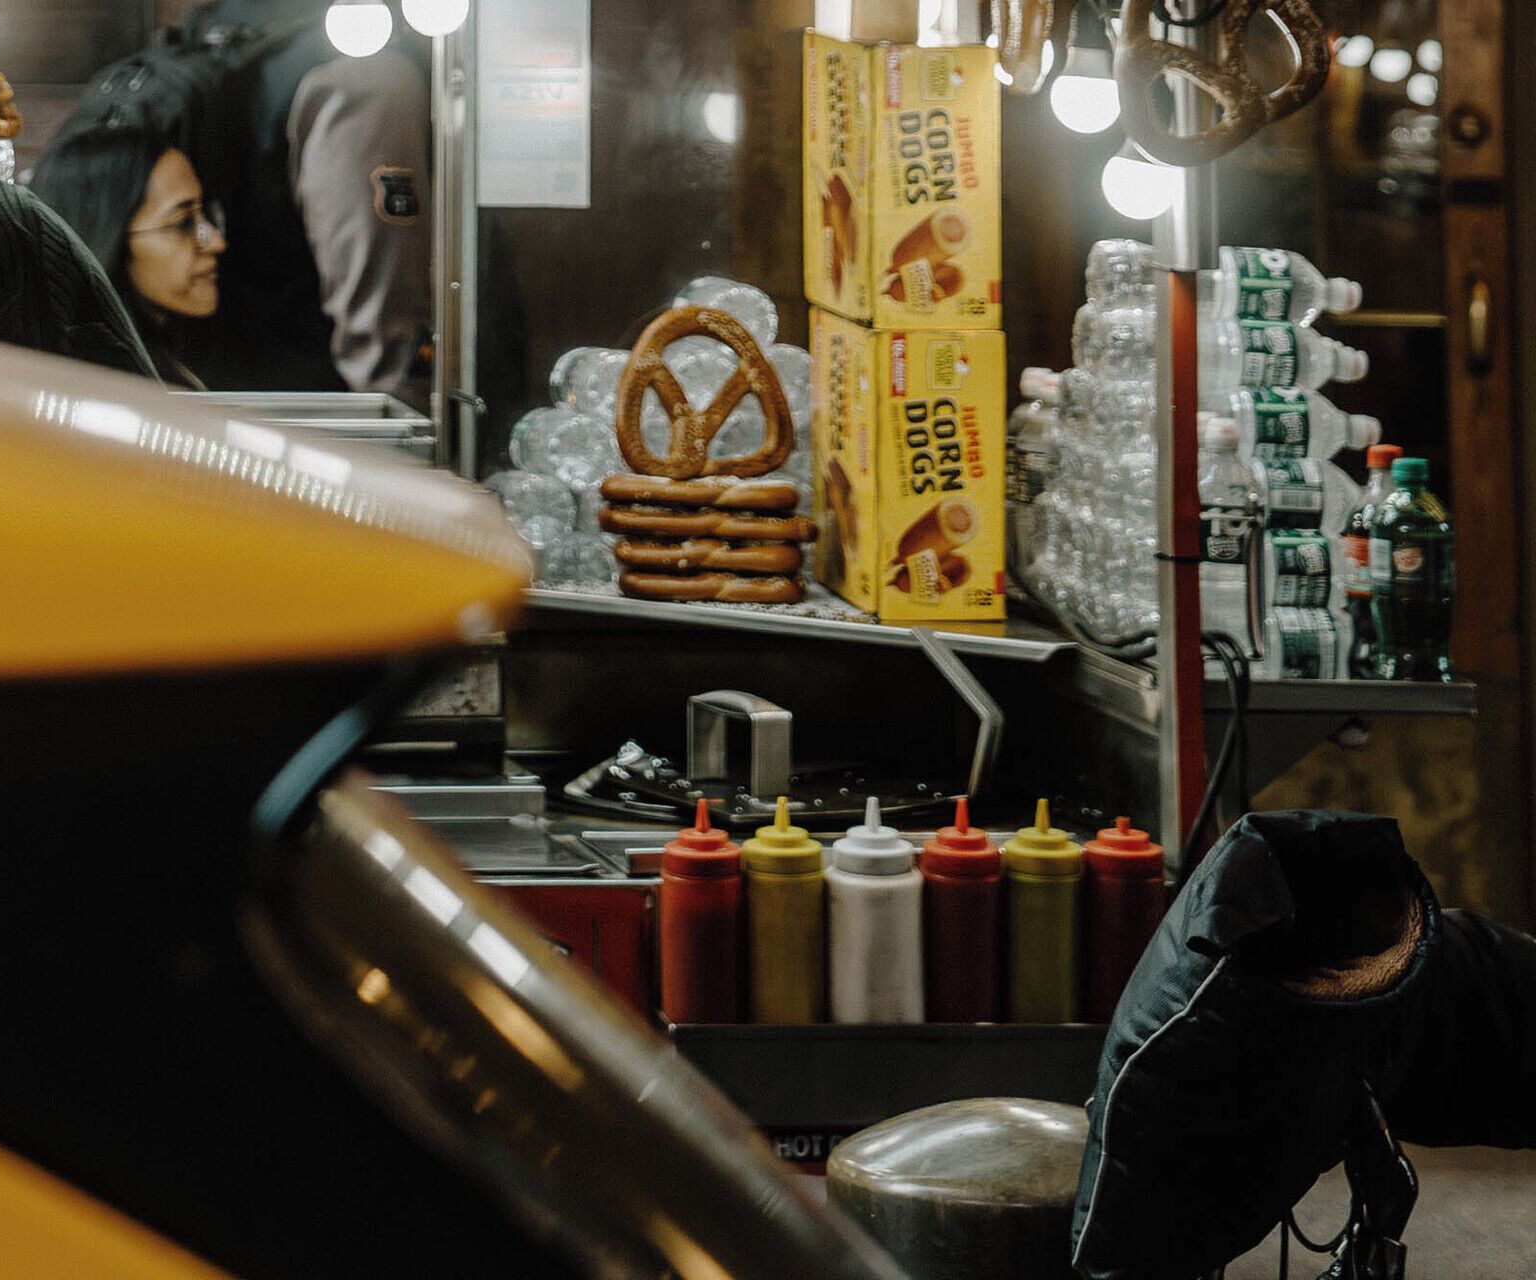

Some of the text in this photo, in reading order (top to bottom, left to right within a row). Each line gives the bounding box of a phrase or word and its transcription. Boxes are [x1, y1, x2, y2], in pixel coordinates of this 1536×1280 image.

[898, 109, 930, 206] DOGS
[925, 108, 959, 203] CORN
[955, 116, 980, 190] JUMBO
[904, 399, 937, 496] DOGS
[933, 397, 965, 492] CORN
[962, 406, 985, 479] JUMBO
